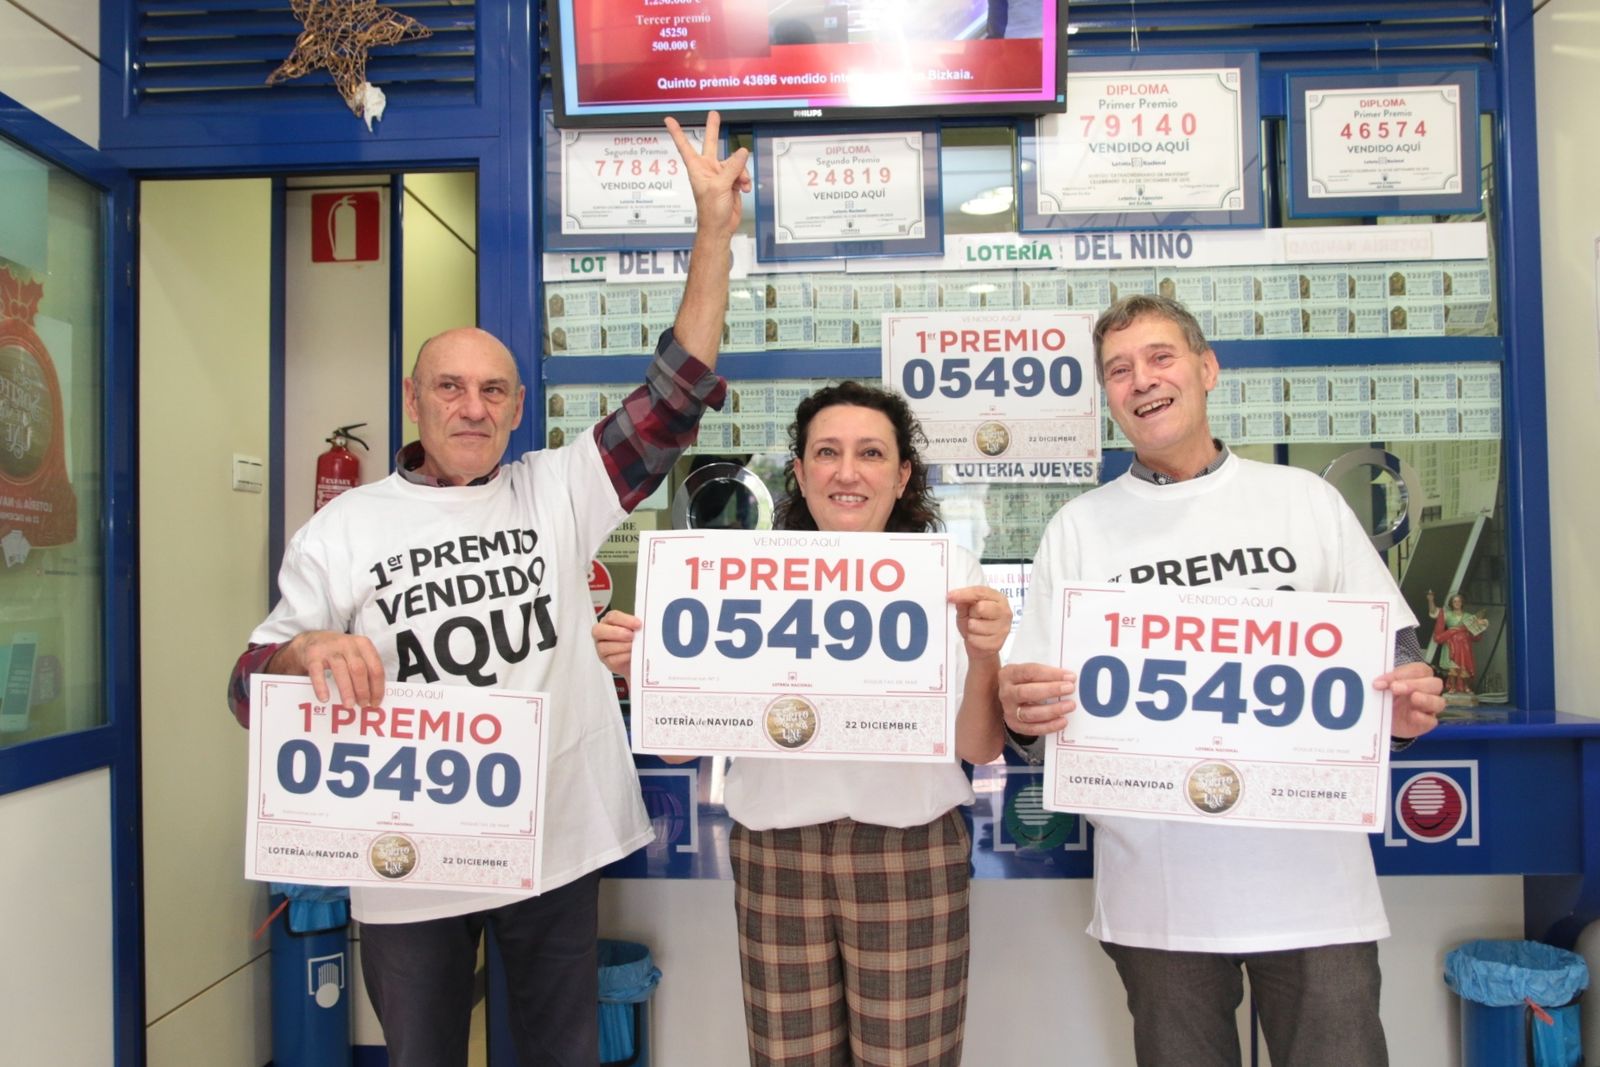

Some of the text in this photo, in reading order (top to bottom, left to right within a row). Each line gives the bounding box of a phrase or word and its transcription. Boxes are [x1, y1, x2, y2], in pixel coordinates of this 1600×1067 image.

[636, 13, 711, 26] Tercer premio
[659, 28, 688, 38] 45250
[652, 40, 697, 51] 500.000 €
[657, 77, 697, 89] Quinto
[699, 75, 740, 89] premio
[743, 74, 777, 87] 43696
[780, 72, 827, 85] vendido
[928, 68, 974, 81] Bizkaia.
[1106, 84, 1170, 96] DIPLOMA
[1098, 98, 1178, 110] Primer Premio
[1359, 98, 1406, 108] DIPLOMA
[793, 109, 823, 118] PHILIPS
[1353, 109, 1412, 119] Primer Premio
[613, 136, 659, 146] DIPLOMA
[1088, 138, 1190, 154] VENDIDO AQUÍ
[1347, 143, 1421, 154] VENDIDO AQUÍ
[604, 147, 668, 159] Segundo Premio
[825, 145, 871, 156] DIPLOMA
[816, 155, 881, 167] Segundo Premio
[600, 180, 673, 192] VENDIDO AQUÍ
[813, 189, 886, 200] VENDIDO AQUÍ
[966, 240, 1053, 262] LOTERÍA
[1074, 234, 1122, 261] DEL
[619, 250, 664, 274] DEL
[939, 328, 1066, 353] PREMIO
[902, 356, 1083, 399] 05490
[936, 437, 968, 445] NAVIDAD
[1029, 462, 1093, 478] JUEVES
[753, 536, 841, 549] VENDIDO AQUÍ
[409, 528, 539, 577] PREMIO
[1130, 546, 1297, 587] PREMIO
[719, 557, 906, 592] PREMIO
[376, 556, 546, 626] VENDIDO
[1178, 593, 1274, 608] VENDIDO AQUÍ
[396, 587, 558, 687] AQUÍ
[661, 597, 929, 662] 05490
[1141, 614, 1343, 658] PREMIO
[415, 687, 444, 700] AQUÍ
[1078, 655, 1365, 730] 05490
[331, 704, 502, 745] PREMIO
[655, 716, 695, 727] LOTERÍA
[707, 717, 754, 727] NAVIDAD
[845, 721, 857, 729] 22
[860, 721, 918, 730] DICIEMBRE
[277, 739, 521, 808] 05490
[1069, 775, 1112, 787] LOTERÍA
[1124, 779, 1174, 790] NAVIDAD
[1271, 788, 1284, 796] 22
[1287, 789, 1348, 799] DICIEMBRE
[268, 846, 305, 857] LOTERÍA
[316, 850, 359, 859] NAVIDAD
[442, 857, 454, 865] 22
[456, 858, 509, 867] DICIEMBRE
